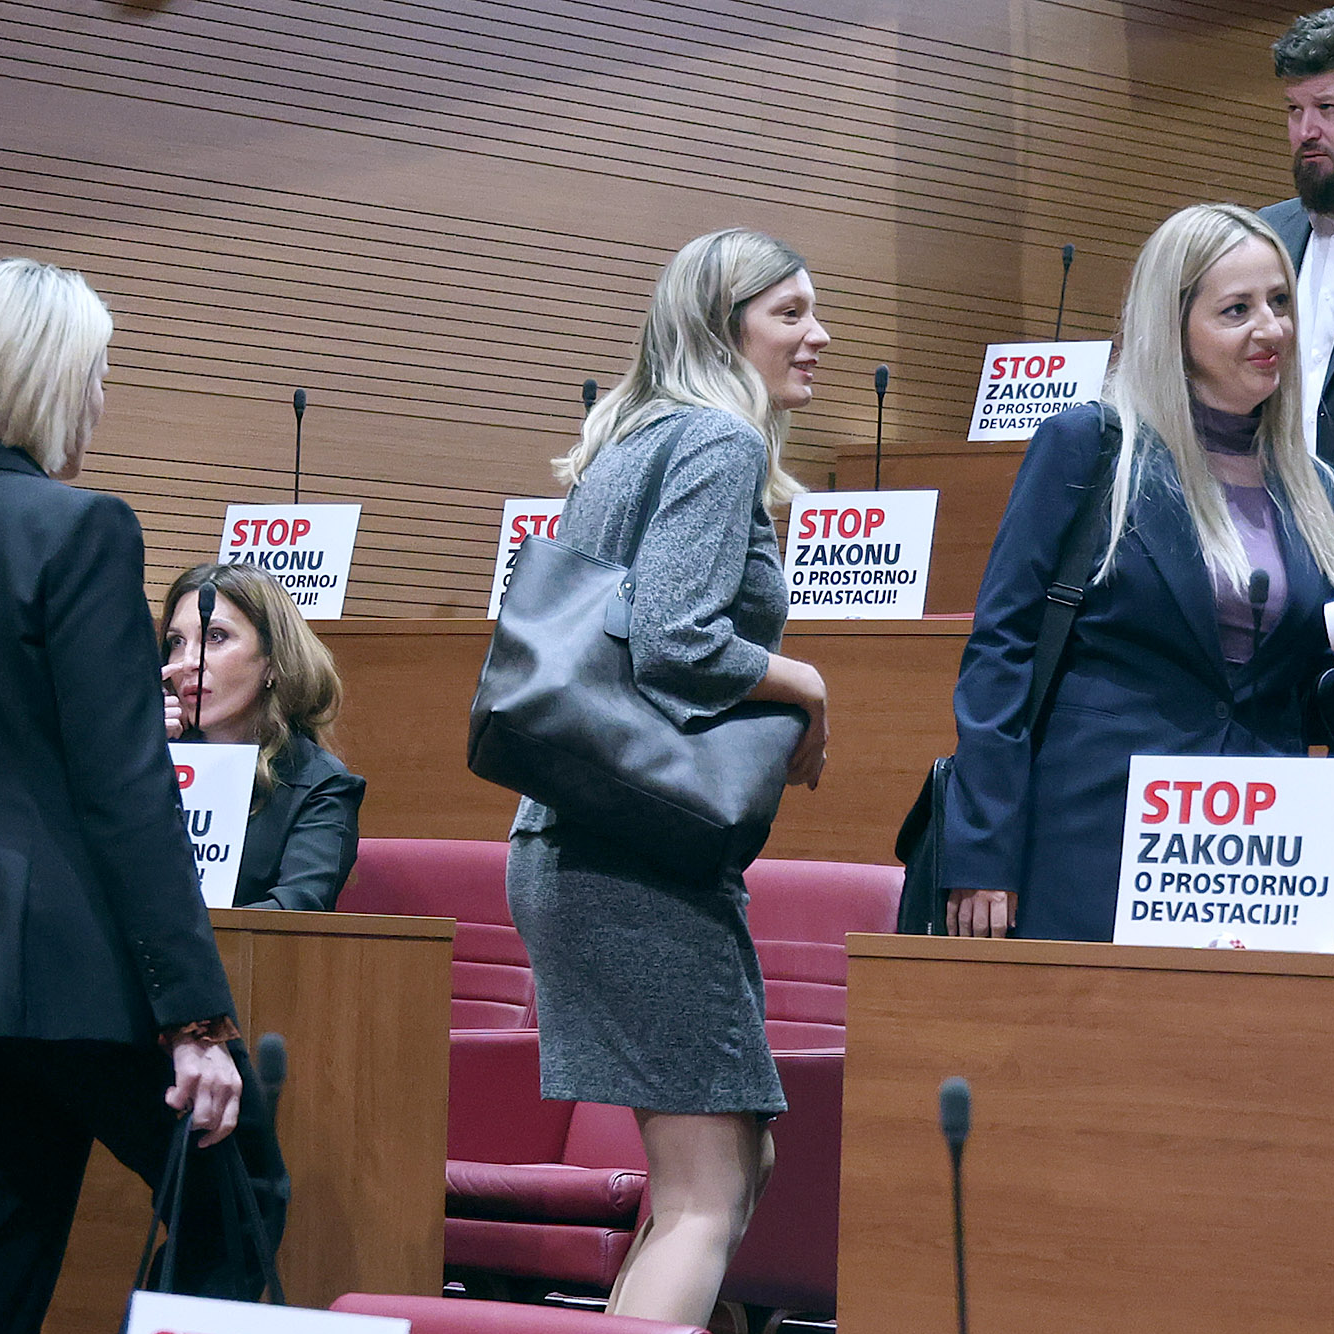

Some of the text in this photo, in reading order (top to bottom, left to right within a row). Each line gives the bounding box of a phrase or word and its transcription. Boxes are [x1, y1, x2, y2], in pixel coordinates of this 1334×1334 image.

[990, 356, 1066, 380] STOP
[985, 382, 1077, 400] ZAKONU
[983, 404, 993, 414] O
[979, 418, 1041, 429] DEVASTA
[230, 519, 311, 546] STOP
[798, 508, 885, 539] STOP
[795, 544, 901, 566] ZAKONU
[275, 575, 338, 588] TORNOJ
[793, 570, 917, 586] O PROSTORNOJ
[789, 589, 897, 605] DEVASTACIJI!
[1141, 780, 1276, 825] STOP
[1137, 833, 1303, 866] ZAKONU
[1135, 872, 1329, 897] O PROSTORNOJ
[1131, 900, 1298, 925] DEVASTACIJI!
